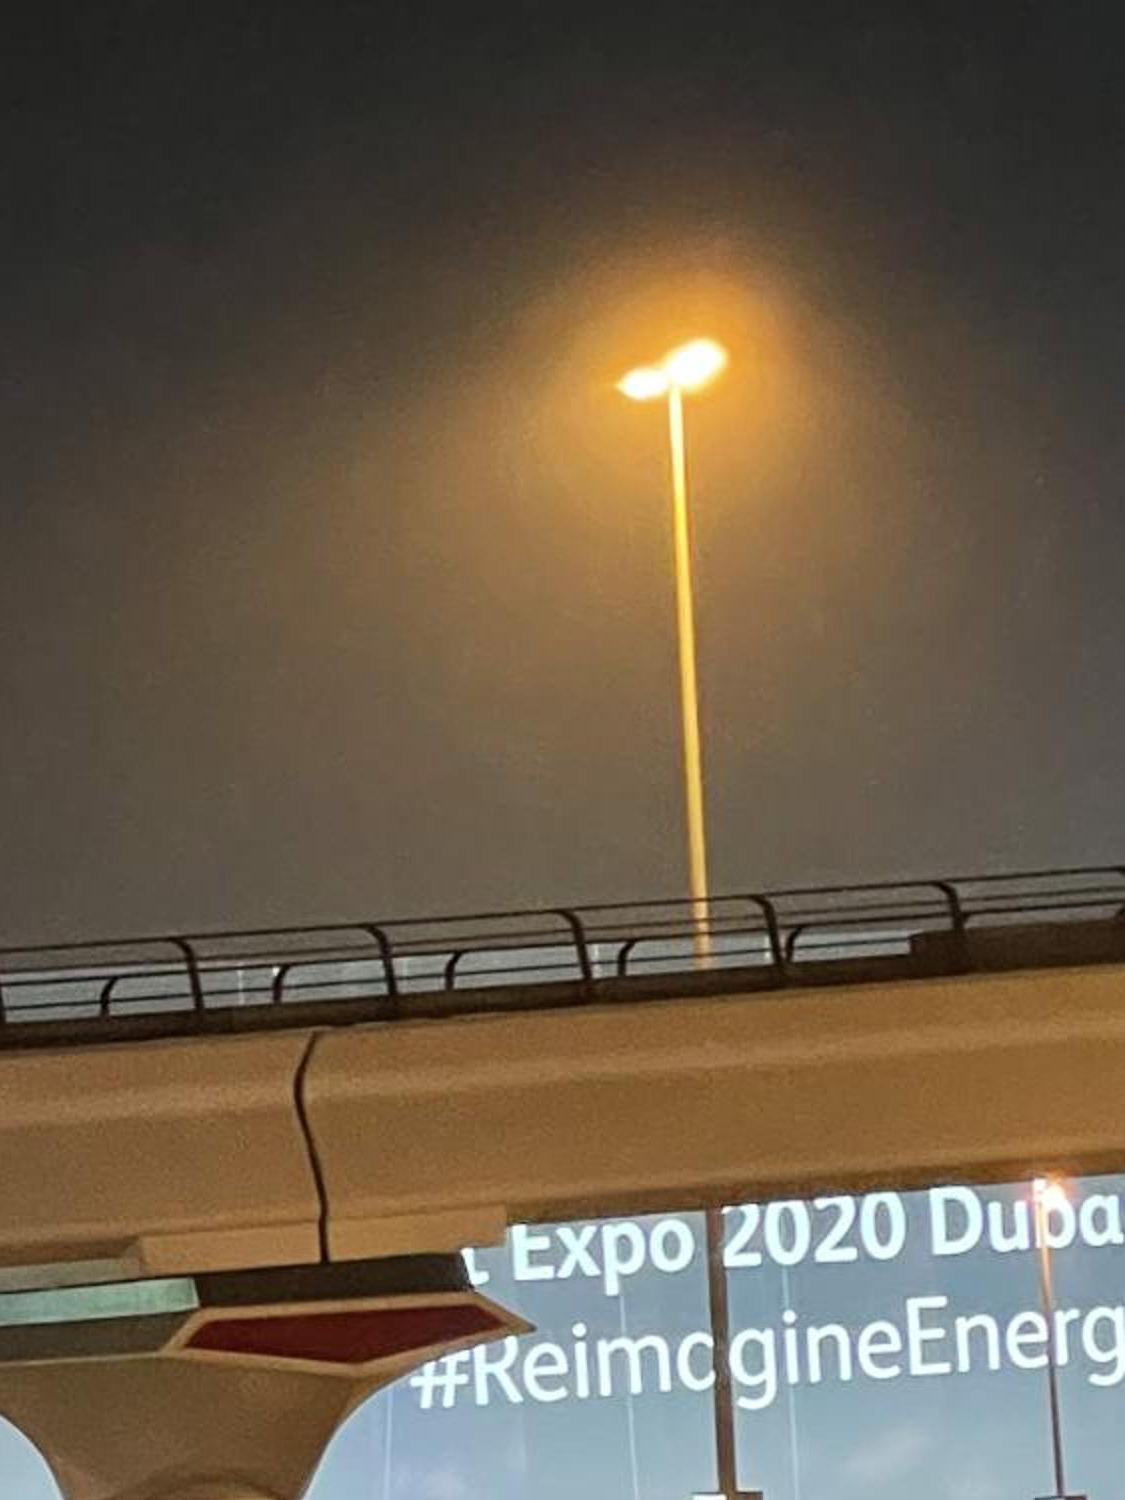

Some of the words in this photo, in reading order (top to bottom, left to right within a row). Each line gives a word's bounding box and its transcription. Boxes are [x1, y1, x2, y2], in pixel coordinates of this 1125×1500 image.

[512, 1218, 695, 1296] Expo
[722, 1191, 906, 1268] 2020
[928, 1177, 1125, 1256] Duba
[409, 1294, 1125, 1411] #ReimagineEnerg
